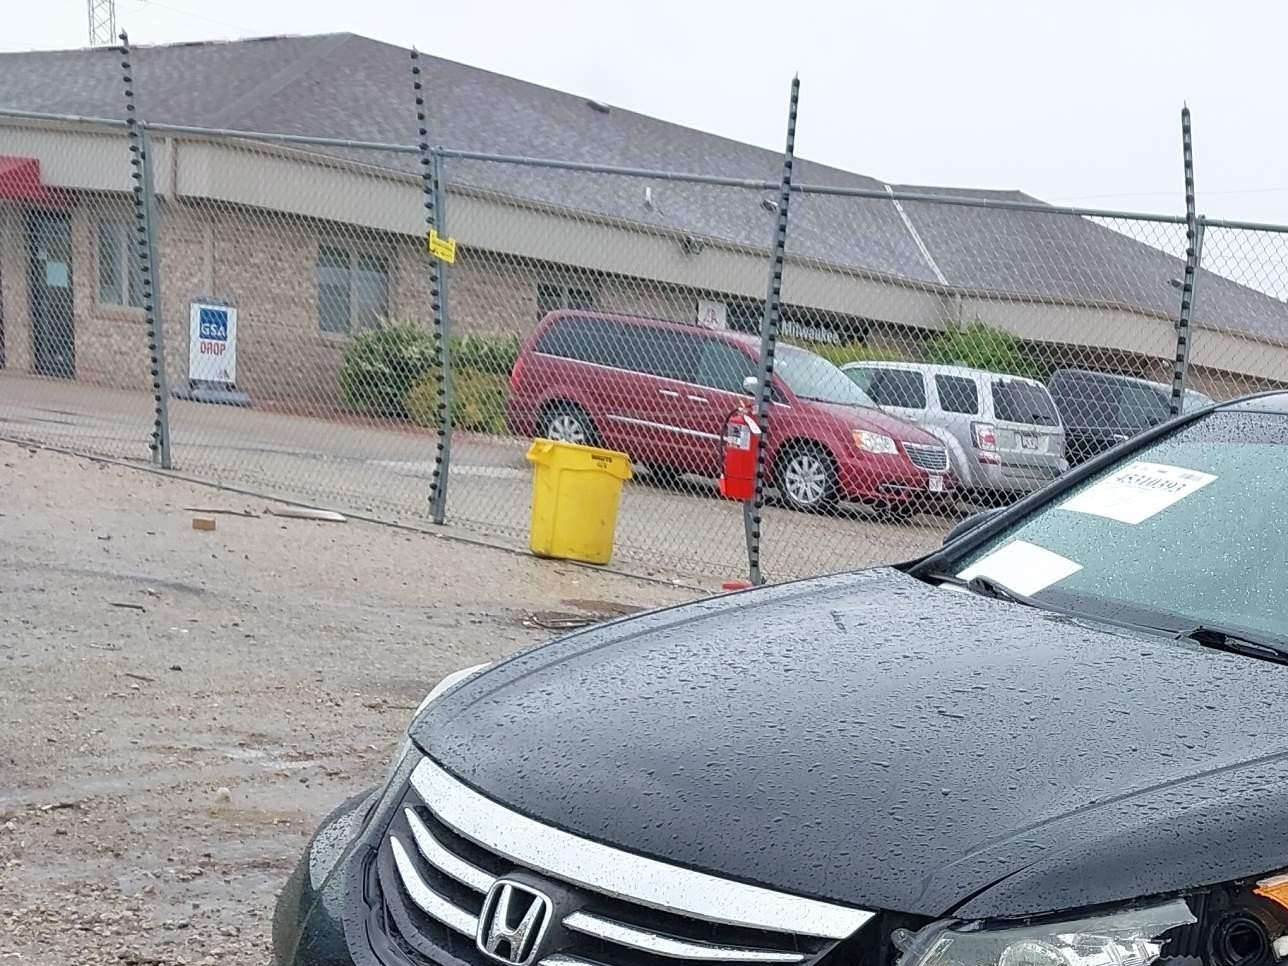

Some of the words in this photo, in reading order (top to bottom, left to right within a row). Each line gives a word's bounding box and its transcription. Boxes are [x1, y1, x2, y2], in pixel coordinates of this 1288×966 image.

[200, 323, 226, 337] GSA
[781, 320, 839, 344] Milwaukee
[200, 341, 226, 356] DROP
